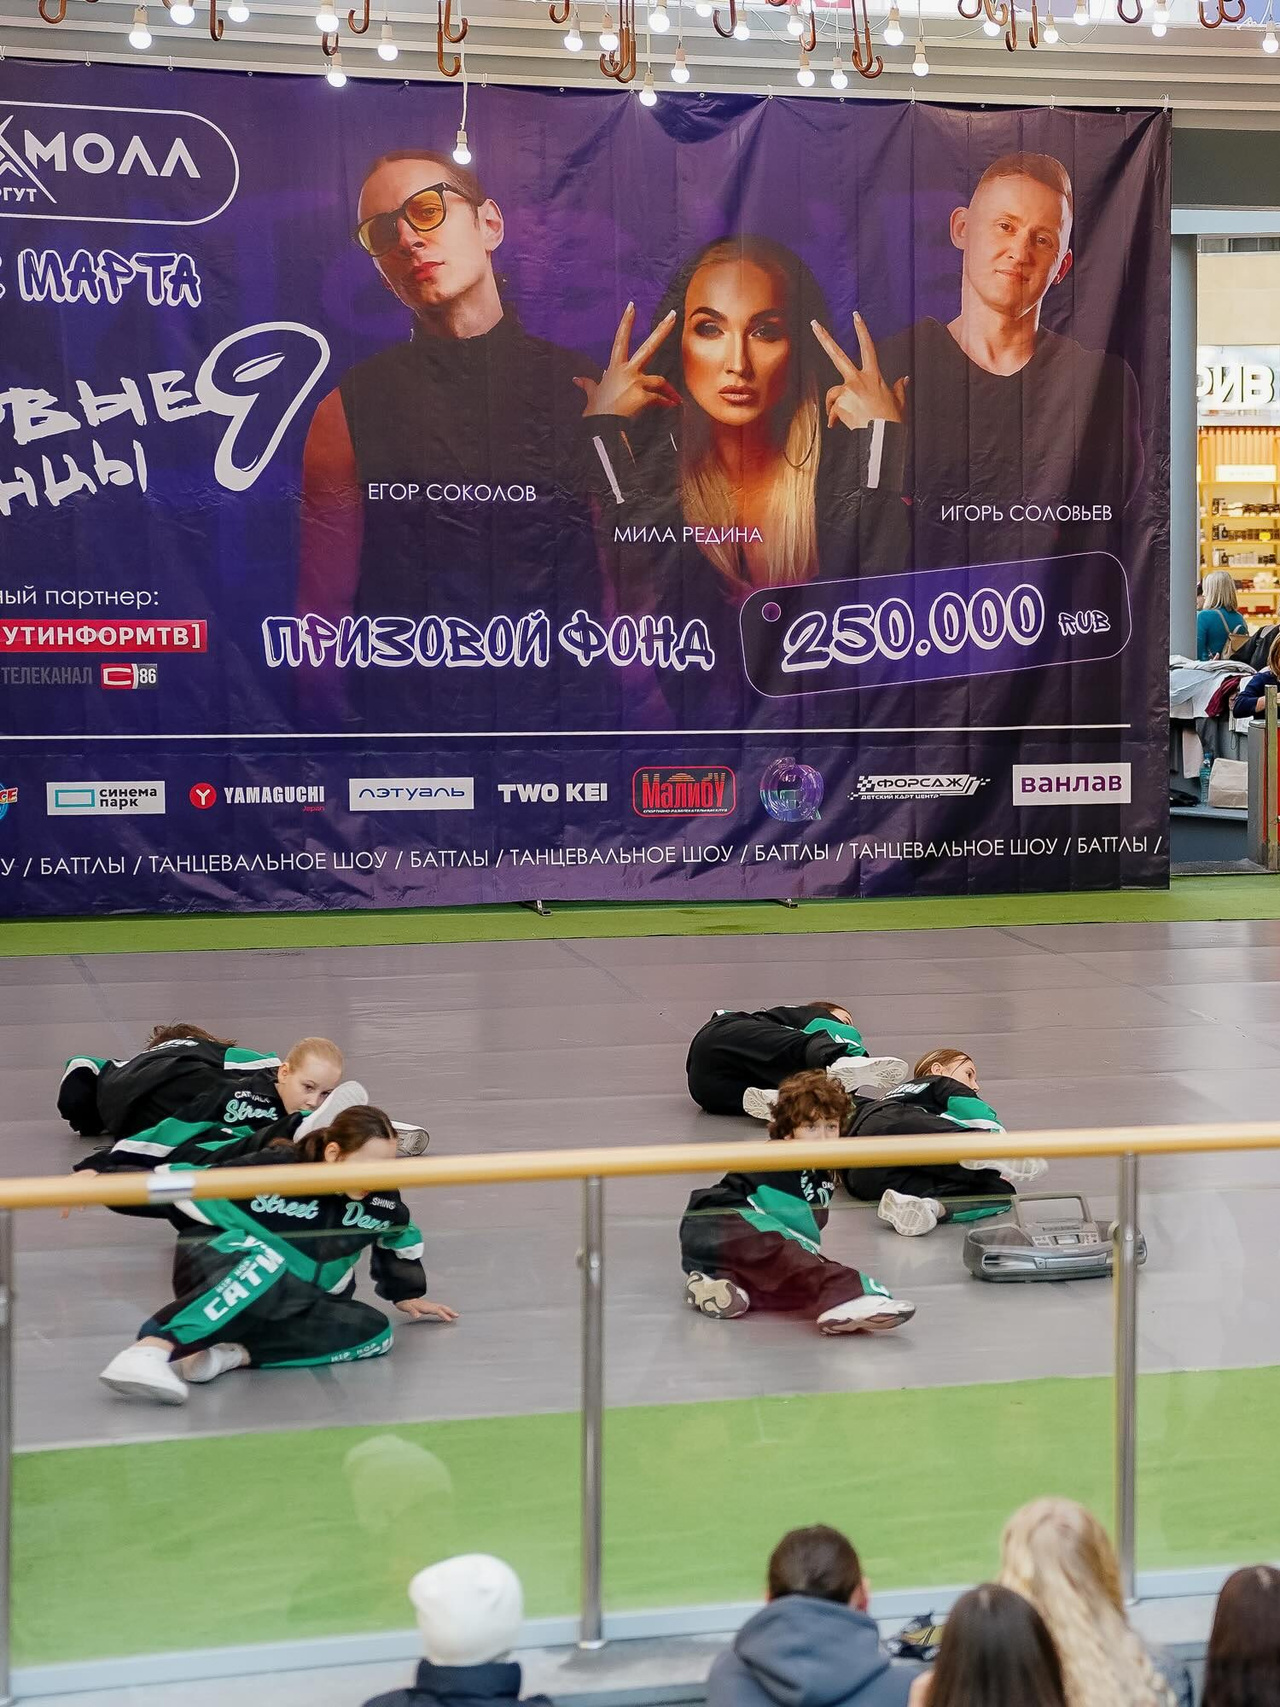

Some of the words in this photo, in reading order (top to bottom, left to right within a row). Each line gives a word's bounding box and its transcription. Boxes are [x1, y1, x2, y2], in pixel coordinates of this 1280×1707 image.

[24, 129, 201, 178] МОЛЛ
[0, 187, 37, 202] ГУТ
[18, 248, 201, 307] МАРТА
[0, 370, 205, 445] ВЫЕ
[367, 483, 419, 501] ЕГОР
[426, 483, 537, 502] СОКОЛОВ
[940, 505, 1004, 522] ИГОРЬ
[1009, 504, 1113, 522] СОЛОВЬЕВ
[613, 526, 677, 544] МИЛА
[682, 526, 763, 545] РЕДИНА
[0, 585, 37, 605] ый
[46, 590, 159, 610] партнер:
[781, 583, 1046, 673] 250.000
[1058, 609, 1111, 636] RUB
[261, 609, 551, 668] ПРИЗОВОЙ
[558, 609, 716, 671] ФОНД
[1, 667, 93, 685] ТЕЛЕКАНАЛ
[876, 777, 964, 788] ФОРСАЖ
[1021, 775, 1123, 793] ванлав
[99, 787, 157, 798] синема
[224, 786, 325, 804] YAMAGUCHI
[498, 784, 560, 803] TWO
[566, 783, 608, 802] KEI
[99, 798, 139, 810] парк
[40, 856, 125, 875] БАТТЛЫ
[149, 852, 327, 874] ТАНЦЕВАЛЬНОЕ
[333, 851, 388, 869] ШОУ
[410, 849, 488, 868] БАТТЛЫ
[510, 846, 676, 867] ТАНЦЕВАЛЬНОЕ
[682, 845, 734, 863] ШОУ
[755, 843, 829, 861] БАТТЛЫ
[849, 839, 1004, 861] ТАНЦЕВАЛЬНОЕ
[1010, 838, 1058, 855] ШОУ
[1078, 836, 1147, 854] БАТТЛЫ
[250, 1194, 320, 1220] Street
[371, 1196, 396, 1210] SHING
